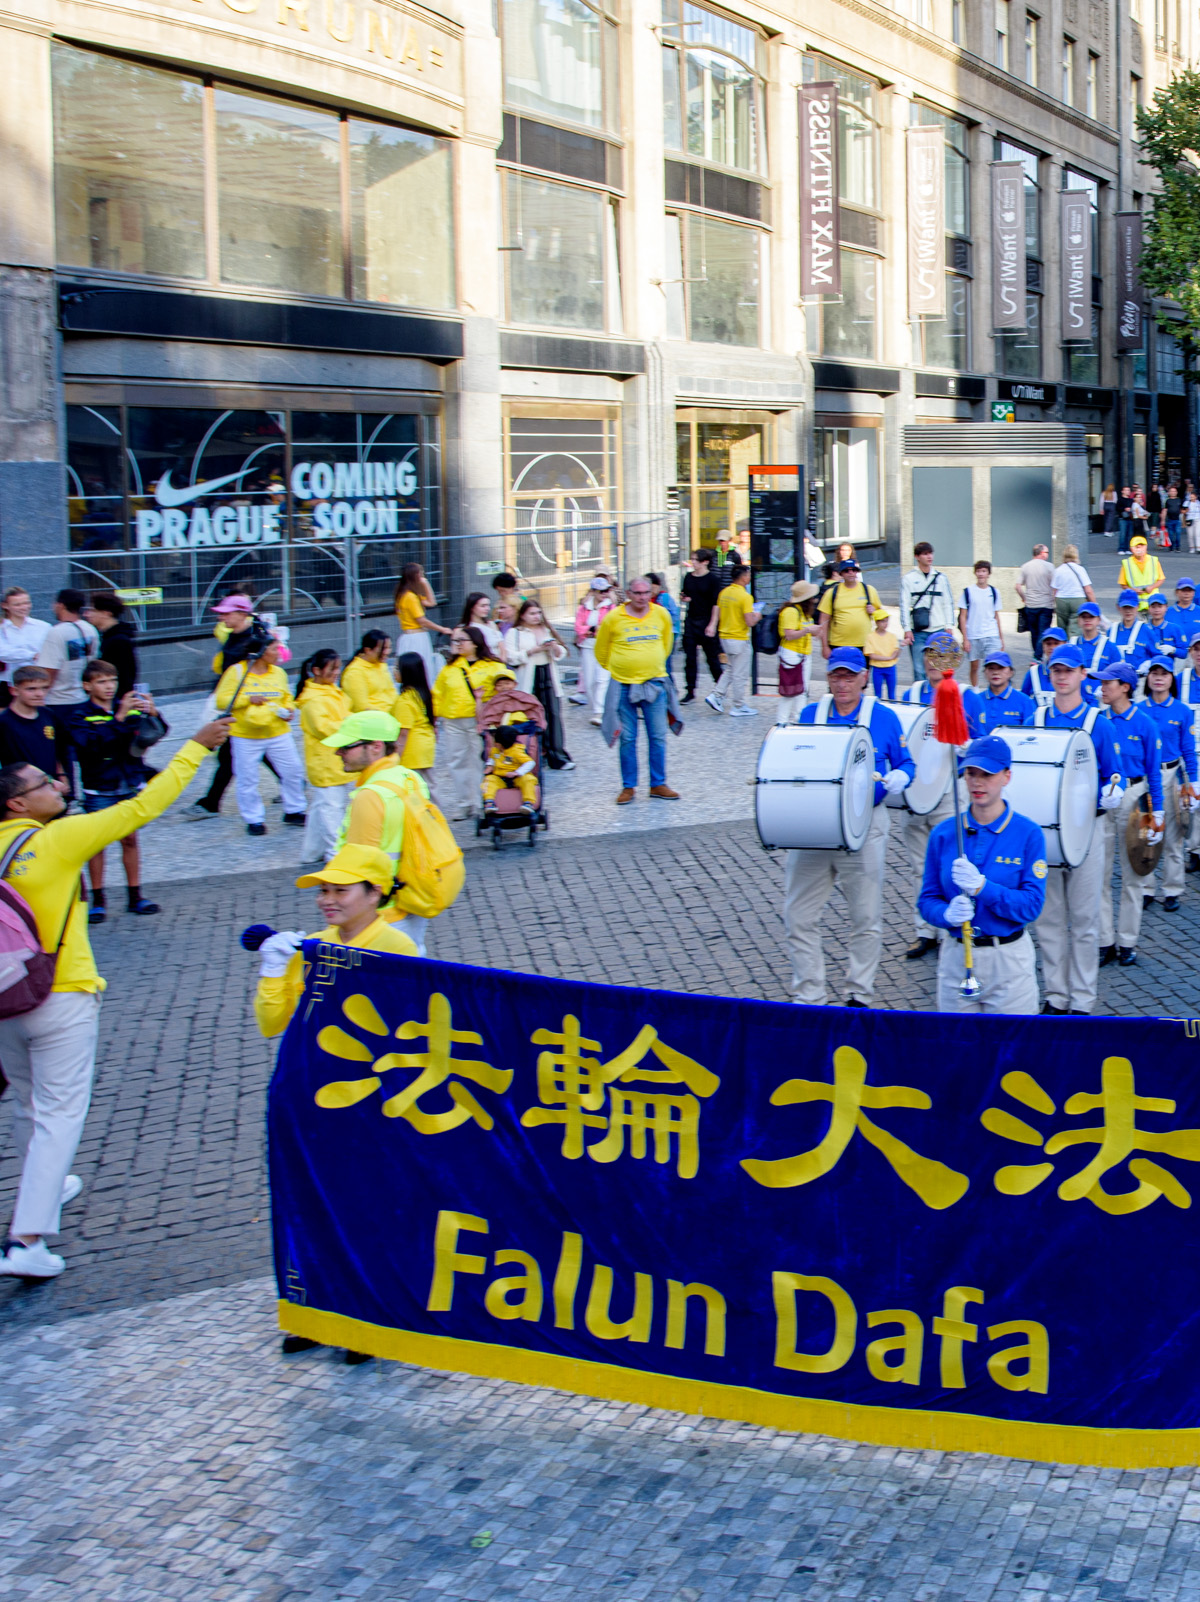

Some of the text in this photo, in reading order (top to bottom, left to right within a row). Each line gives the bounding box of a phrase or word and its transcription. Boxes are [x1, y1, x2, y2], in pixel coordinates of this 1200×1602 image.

[222, 0, 424, 71] RUNA
[919, 210, 937, 263] iWant
[1000, 233, 1017, 281] iWant
[1068, 254, 1084, 298] iWant
[291, 461, 417, 499] COMING
[136, 504, 280, 549] PRAGUE
[313, 500, 398, 539] SOON
[426, 1208, 1050, 1395] Falun Dafa
